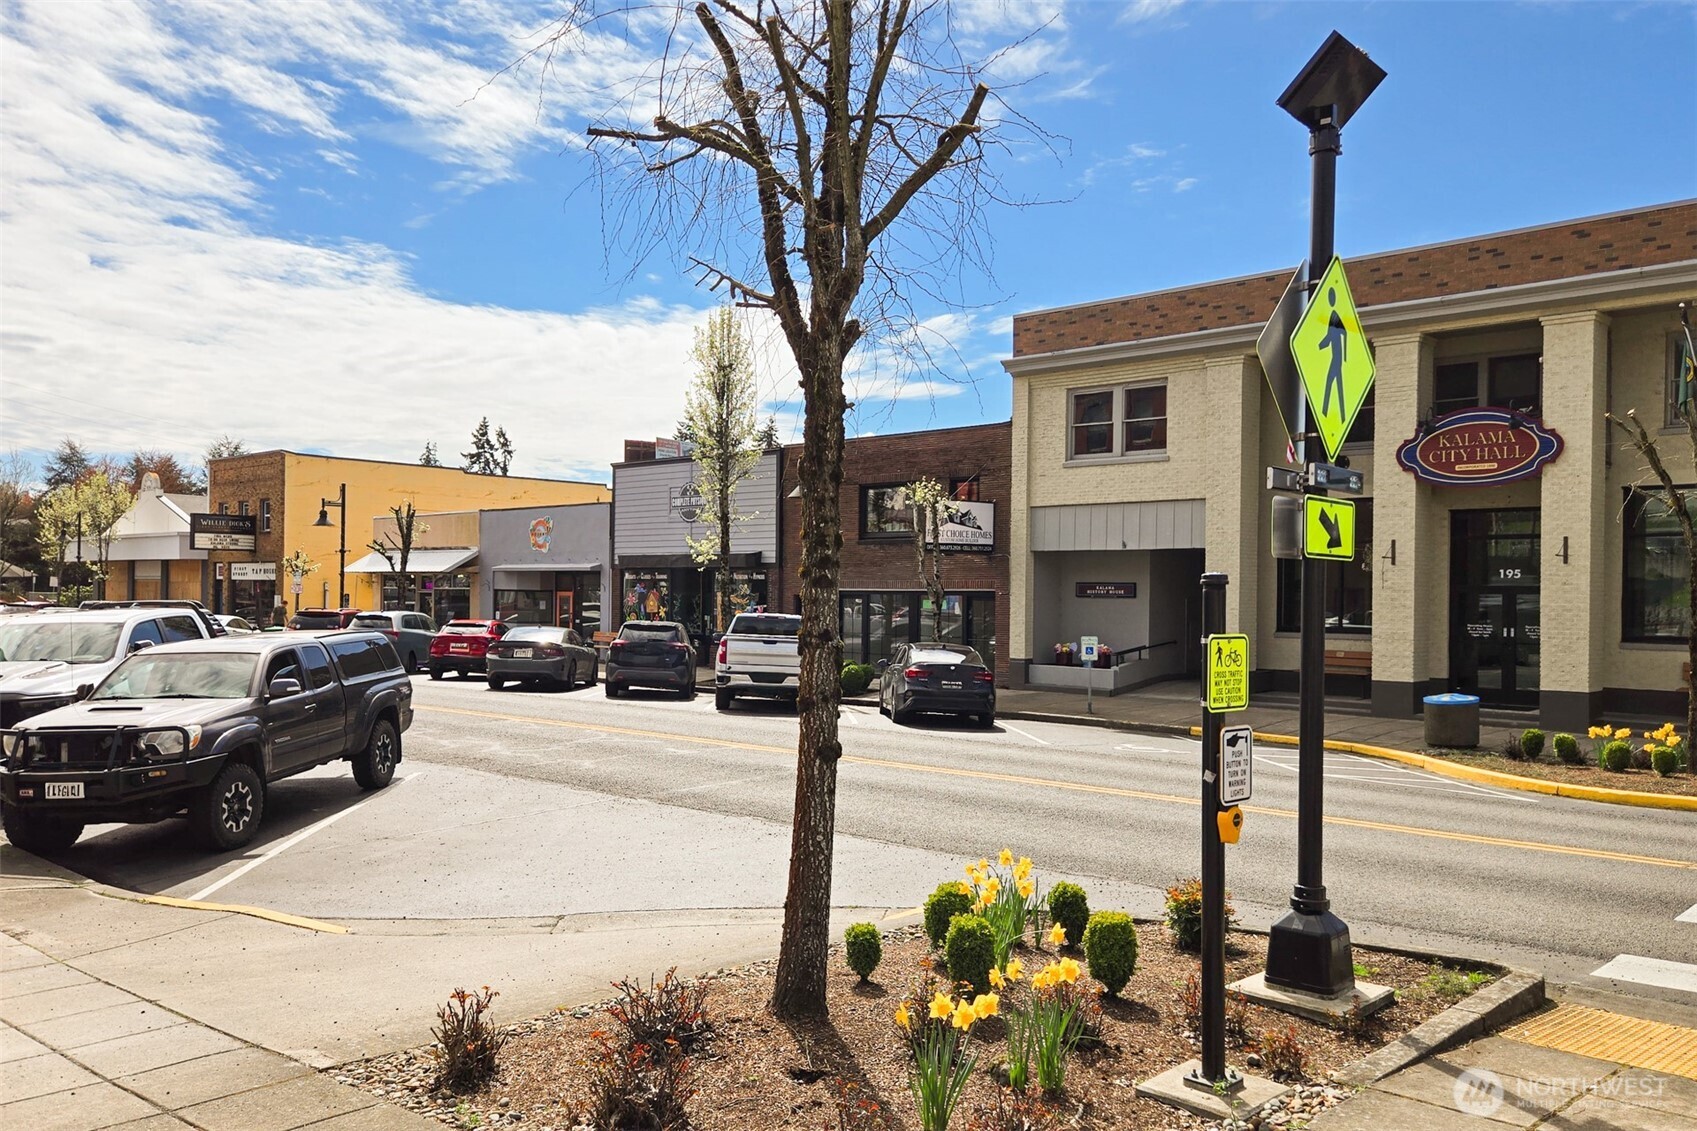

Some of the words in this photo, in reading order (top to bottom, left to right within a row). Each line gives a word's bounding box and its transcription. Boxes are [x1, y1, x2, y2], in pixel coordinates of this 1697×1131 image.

[1440, 430, 1516, 448] KALAMA
[1429, 448, 1471, 463] CITY
[1476, 445, 1527, 460] HALL
[200, 518, 227, 526] WILLIE
[229, 520, 251, 528] DICK'S
[945, 530, 970, 539] CHOICE
[970, 531, 993, 540] HOMES
[1499, 569, 1521, 579] 195
[1214, 671, 1227, 679] CROSS
[1228, 670, 1243, 678] TRAFFIC
[1225, 687, 1241, 695] CAUTION
[1213, 696, 1224, 704] WHEN
[1225, 695, 1243, 703] CROSSING
[1231, 750, 1243, 759] PUSH
[1226, 760, 1242, 769] BUTTON
[1243, 759, 1249, 767] TO
[1228, 769, 1239, 778] TURN
[1240, 768, 1247, 777] ON
[1228, 778, 1246, 788] WARNING
[1230, 788, 1245, 798] LIGHTS
